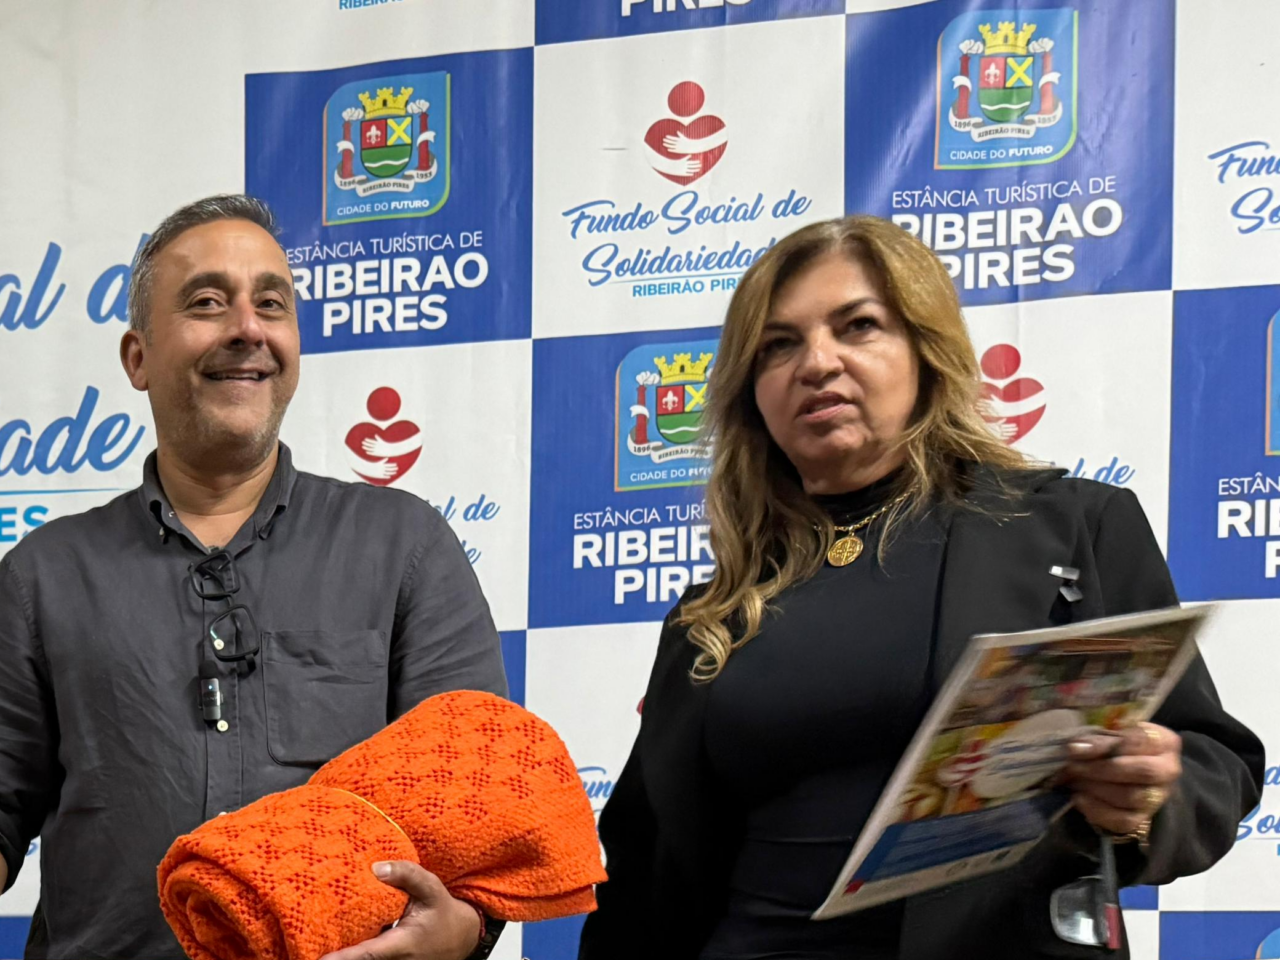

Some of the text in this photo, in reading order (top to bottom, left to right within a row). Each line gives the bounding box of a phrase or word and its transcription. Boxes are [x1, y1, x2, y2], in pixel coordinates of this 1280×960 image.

[950, 145, 1053, 160] CIDADE DO FUTURO
[1207, 141, 1280, 184] Fun
[337, 199, 429, 215] CIDADE DO FUTURO
[892, 175, 1117, 209] ESTÂNCIA TURÍSTICA DE
[562, 189, 812, 239] Fundo Social de
[891, 198, 1122, 250] RIBEIRAO
[287, 231, 483, 264] ESTÂNCIA TURÍSTICA DE
[582, 237, 776, 287] Solidariedad
[86, 232, 151, 325] d
[291, 252, 489, 300] RIBEIRAO
[941, 244, 1075, 290] PIRES
[632, 277, 743, 297] RIBEIRÃO PIR
[323, 294, 448, 337] PIRES
[630, 470, 667, 482] CIDADE
[670, 468, 686, 478] DO
[1094, 456, 1135, 485] de
[1218, 471, 1280, 495] ESTÂN
[463, 494, 500, 521] de
[574, 506, 661, 530] ESTÂNCIA
[573, 524, 716, 569] RIBEIR
